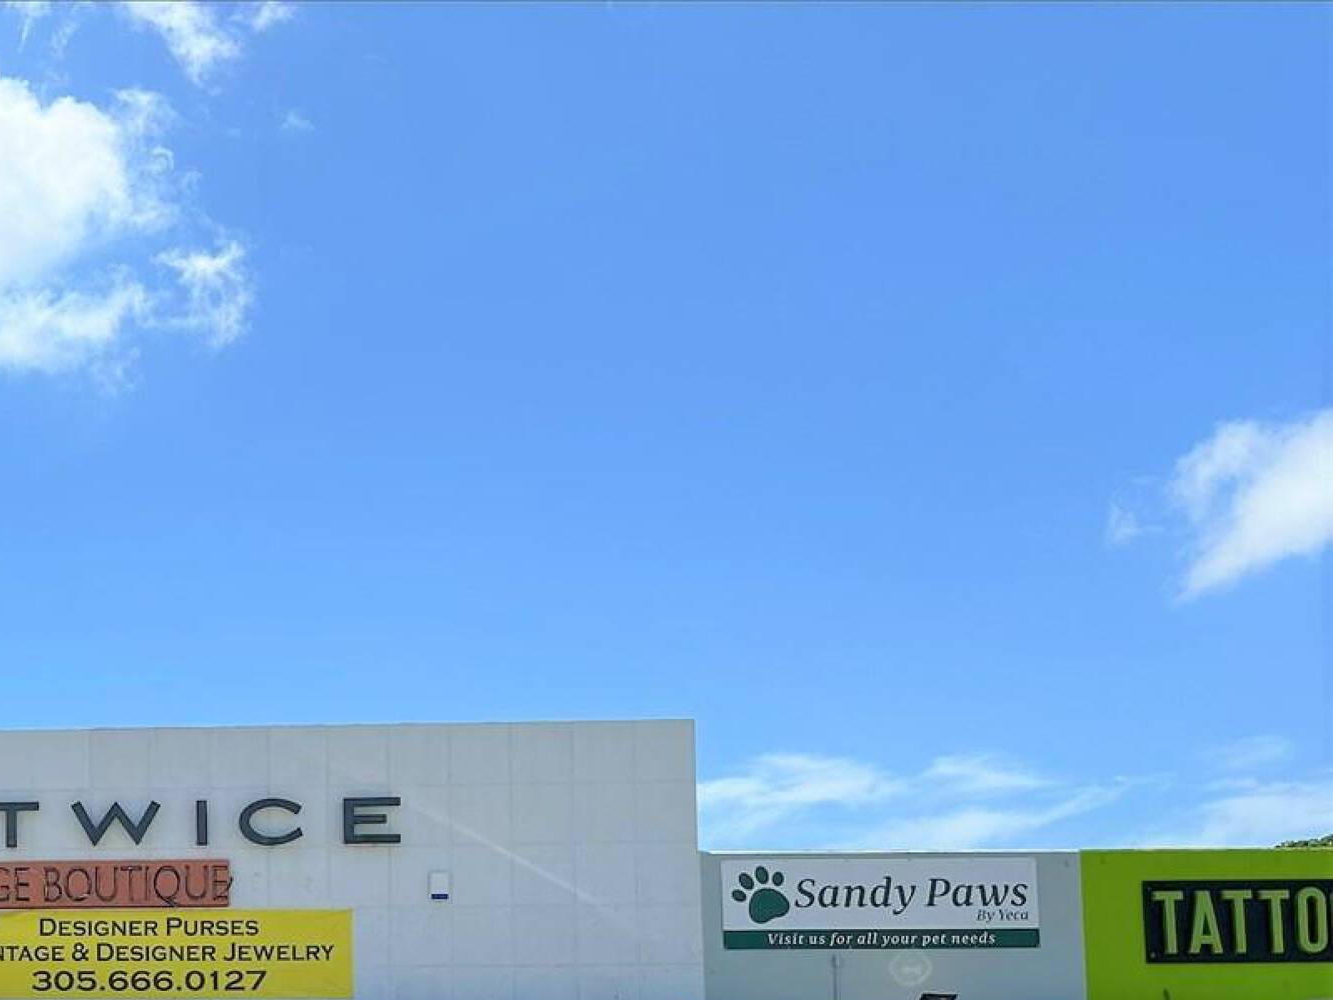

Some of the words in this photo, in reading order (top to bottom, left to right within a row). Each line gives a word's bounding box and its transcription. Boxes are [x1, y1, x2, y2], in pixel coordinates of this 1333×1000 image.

[43, 865, 232, 907] BOUTIQUE
[795, 876, 916, 915] Sandy
[926, 878, 1028, 908] Paws
[977, 909, 995, 923] By
[1153, 886, 1333, 954] TATTO
[39, 918, 158, 936] DESIGNER
[166, 918, 259, 936] PURSES
[767, 933, 804, 945] Visit
[809, 935, 825, 945] us
[829, 932, 852, 949] for
[857, 933, 877, 945] all
[883, 935, 916, 949] your
[922, 934, 947, 949] pet
[951, 932, 996, 945] needs
[71, 943, 88, 961] &
[96, 943, 216, 961] DESIGNER
[223, 943, 334, 961] JEWELRY
[32, 970, 266, 992] 305.666.0127
